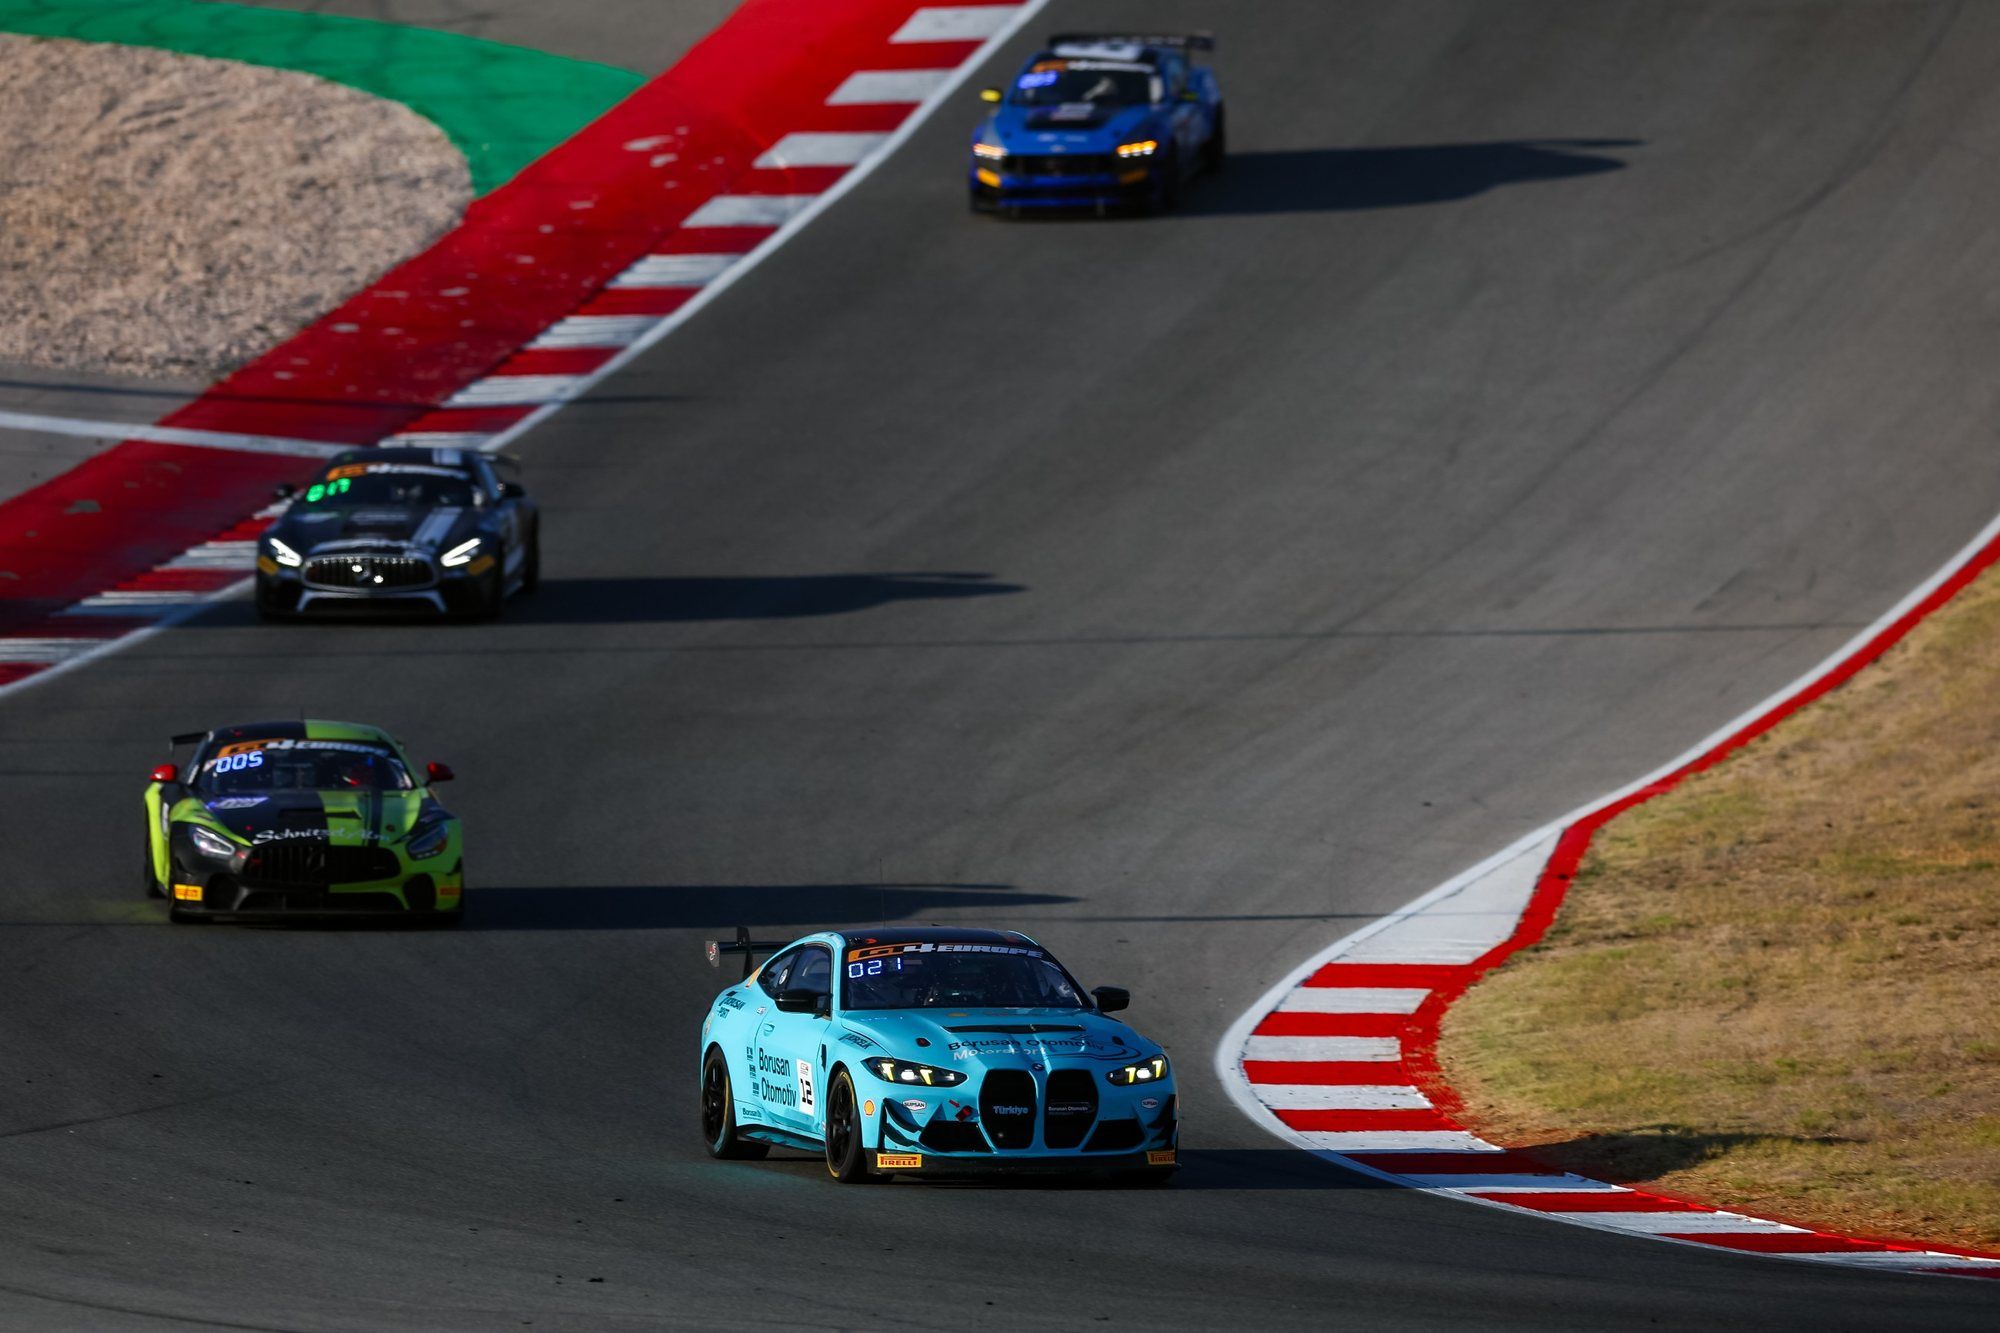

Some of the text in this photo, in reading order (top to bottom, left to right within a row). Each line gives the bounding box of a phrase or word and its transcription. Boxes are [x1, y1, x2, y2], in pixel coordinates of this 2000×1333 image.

[937, 945, 1043, 958] EUROPE
[948, 1039, 1021, 1050] Borusan
[759, 1047, 791, 1077] Borusan
[761, 1076, 797, 1108] Otomotiv
[800, 1077, 813, 1106] 12
[992, 1104, 1029, 1116] Türkiye
[881, 1155, 919, 1166] PIRELLI
